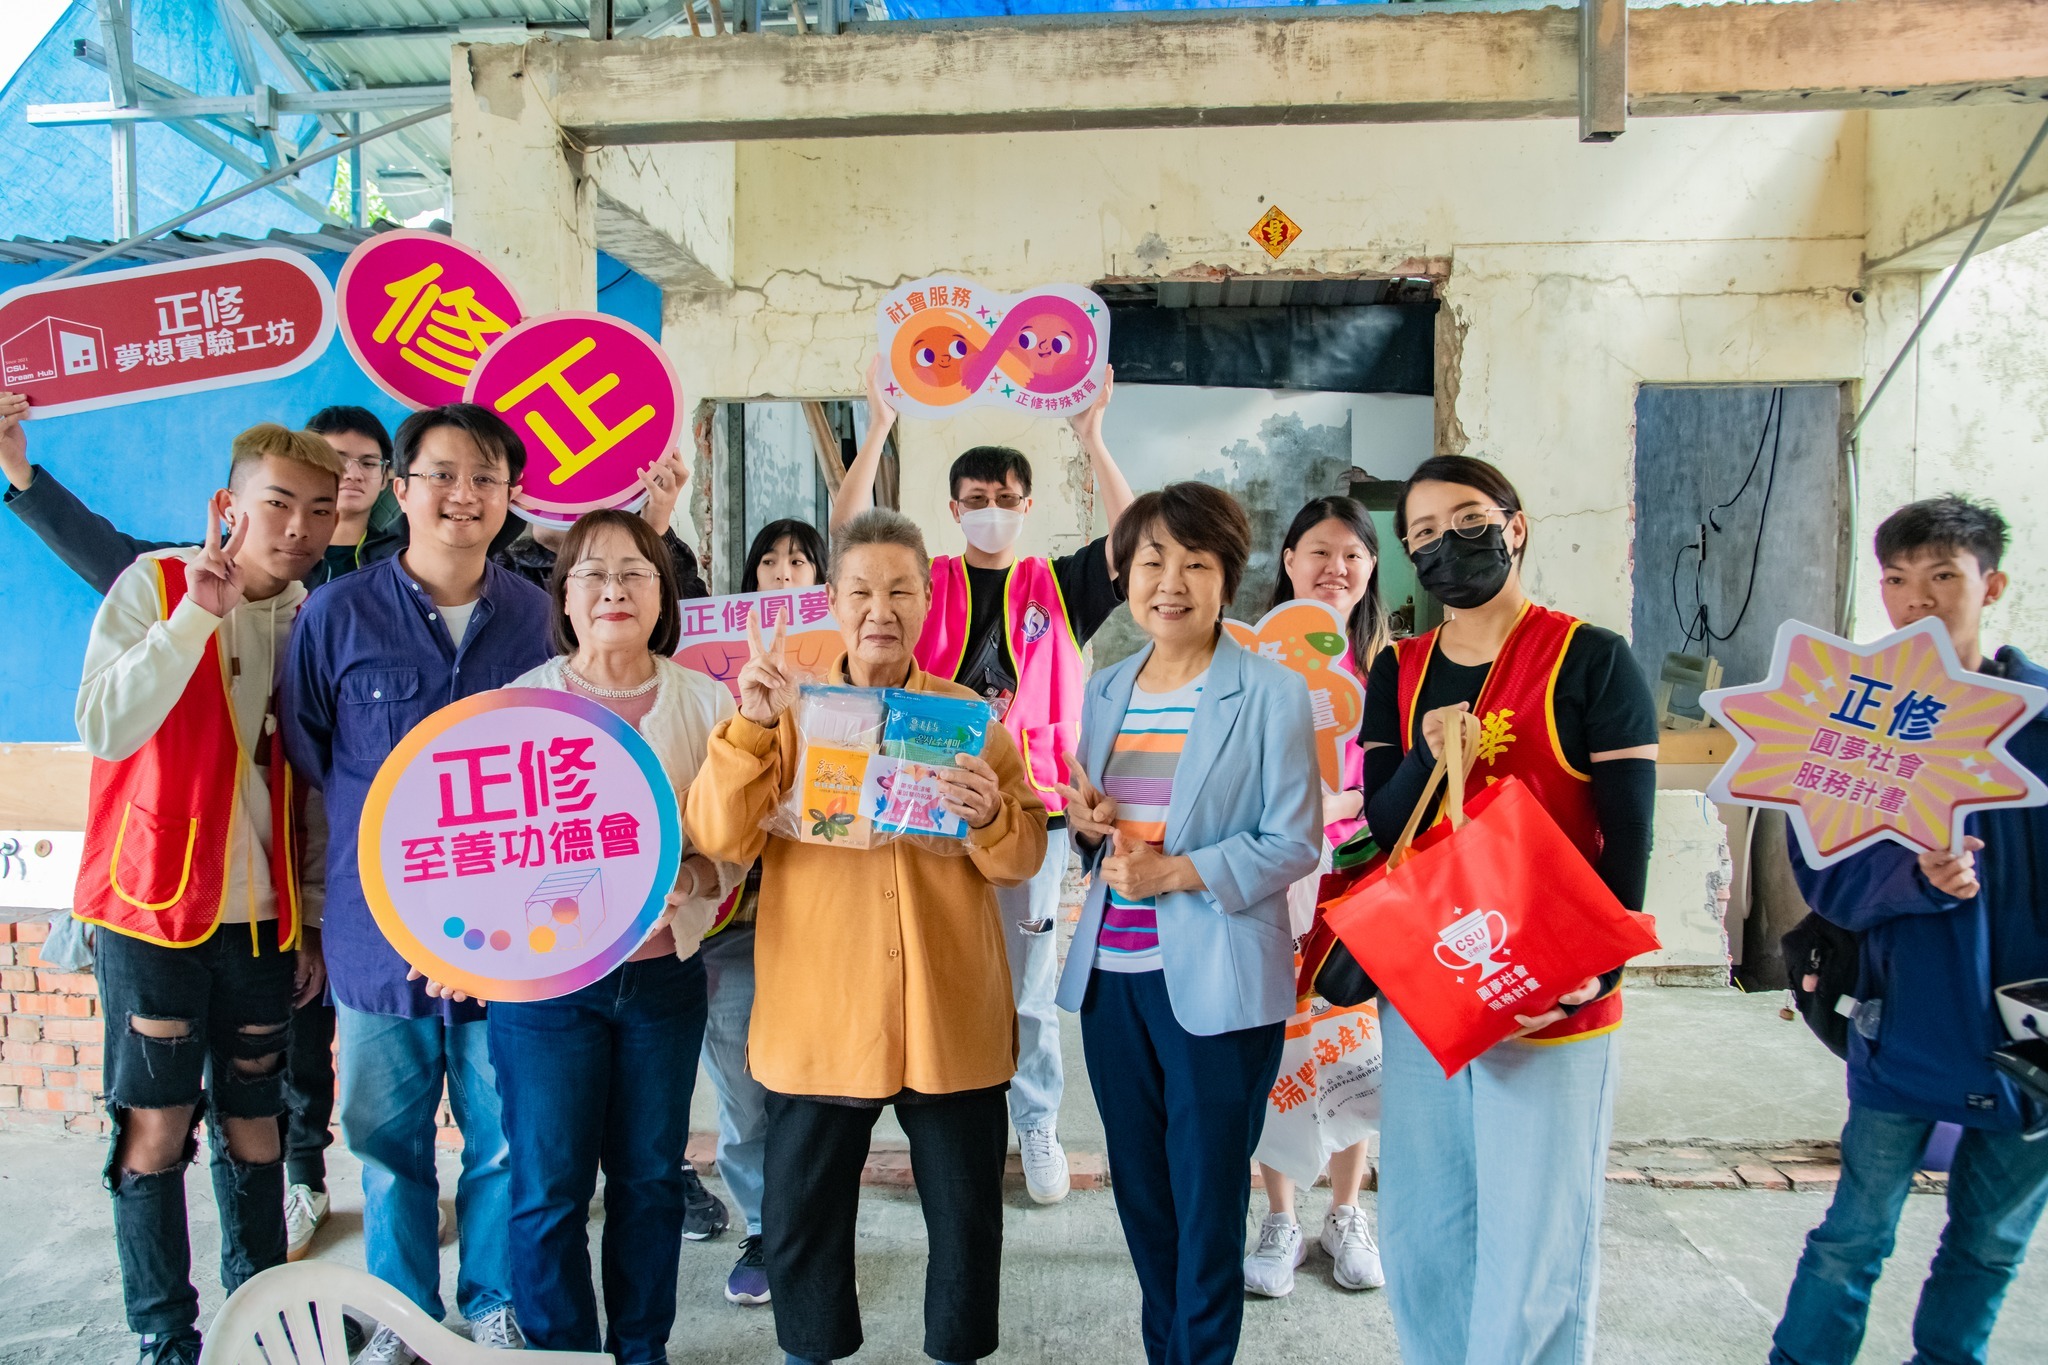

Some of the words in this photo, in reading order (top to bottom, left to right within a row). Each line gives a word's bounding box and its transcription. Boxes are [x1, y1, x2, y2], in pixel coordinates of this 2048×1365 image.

[154, 286, 245, 336] 正修
[372, 263, 512, 388] 修
[885, 285, 972, 324] 社會服務
[114, 318, 295, 373] 夢想實驗工坊
[7, 373, 34, 383] Dream
[37, 369, 54, 377] Hub
[1015, 378, 1097, 411] 正修特殊教育
[494, 336, 656, 486] 正
[683, 590, 830, 637] 正修圓夢
[1829, 674, 1947, 742] 正修
[1808, 727, 1925, 781] 圓夢社會
[432, 737, 598, 828] 正修
[1793, 760, 1908, 815] 服務計畫
[401, 811, 641, 884] 至善功德會
[1455, 927, 1486, 952] CSU
[1475, 964, 1529, 1002] 圓夢社會
[1487, 977, 1542, 1012] 服務計畫
